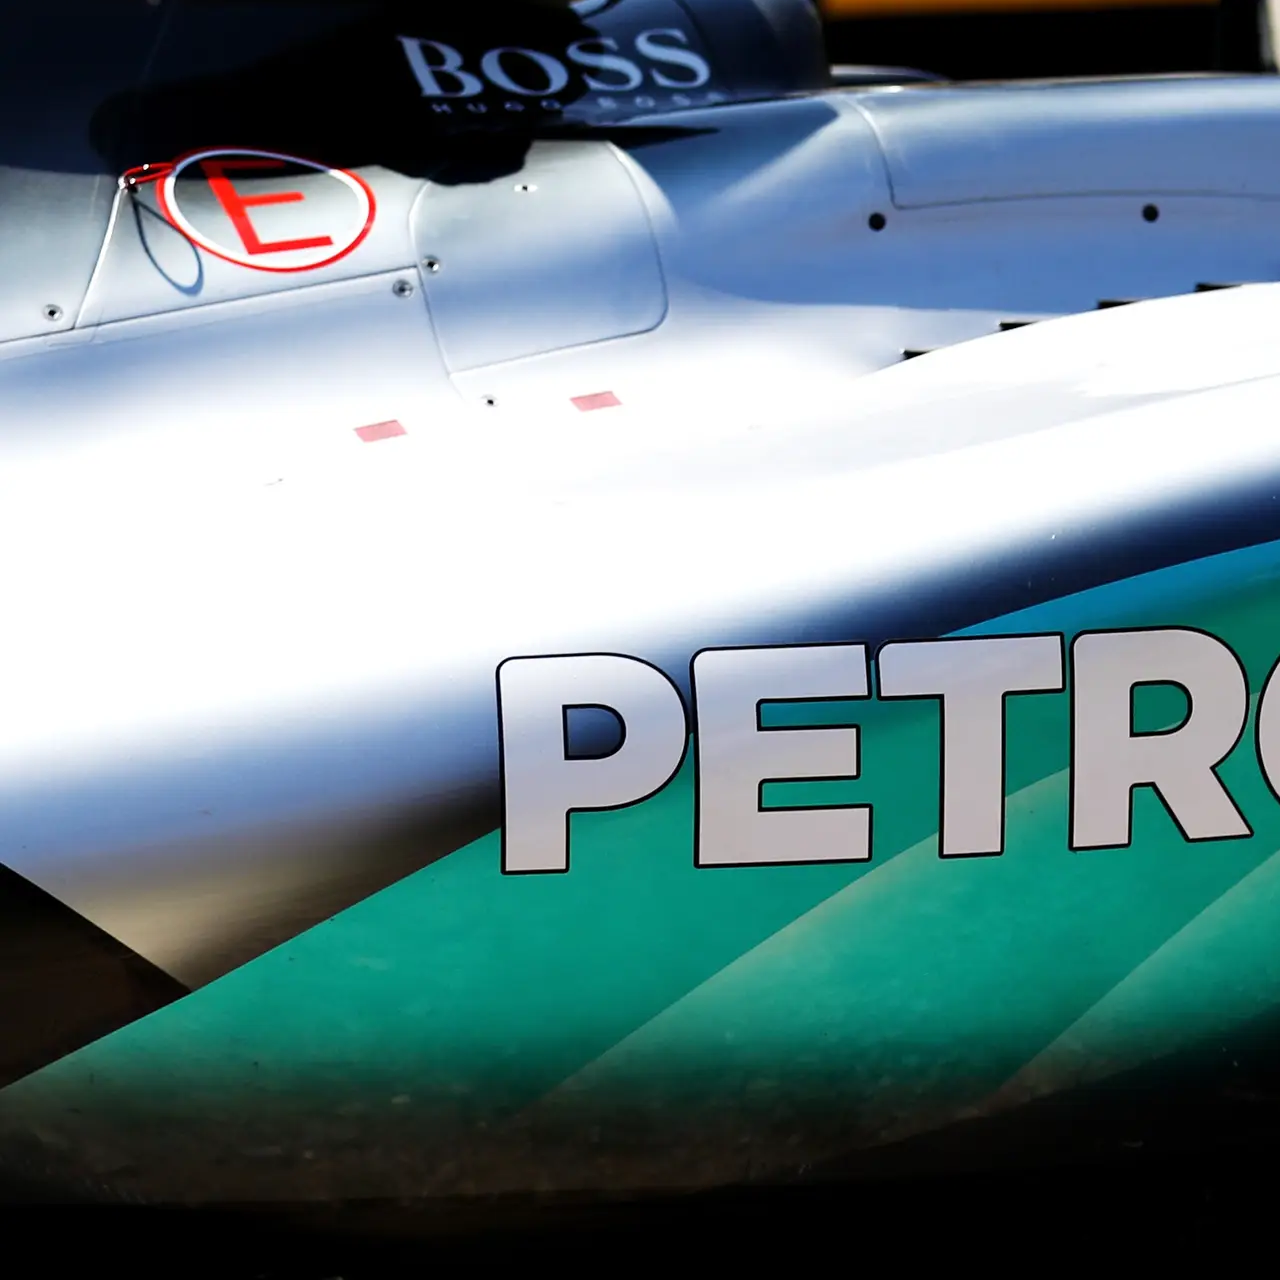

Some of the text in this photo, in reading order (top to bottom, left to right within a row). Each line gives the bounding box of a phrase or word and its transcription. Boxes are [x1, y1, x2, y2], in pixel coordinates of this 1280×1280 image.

[396, 27, 711, 98] BOSS
[431, 99, 562, 115] HUGO
[202, 160, 333, 256] E
